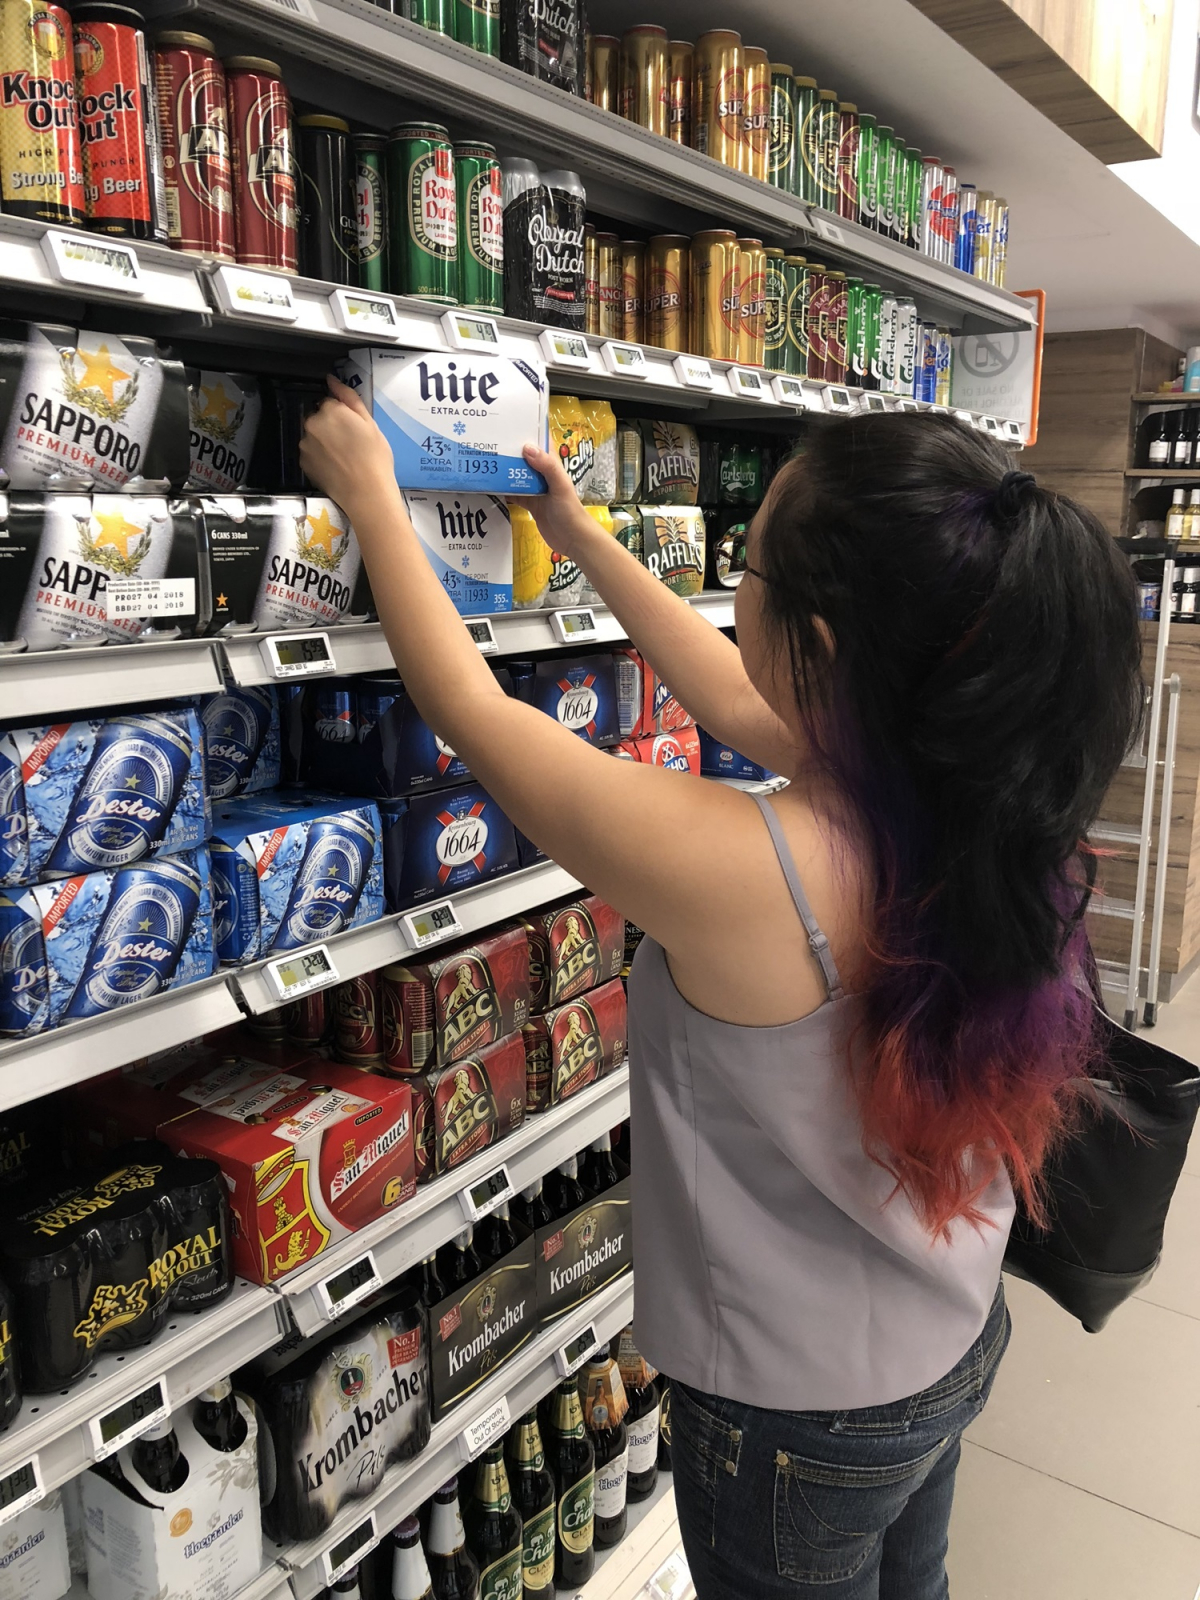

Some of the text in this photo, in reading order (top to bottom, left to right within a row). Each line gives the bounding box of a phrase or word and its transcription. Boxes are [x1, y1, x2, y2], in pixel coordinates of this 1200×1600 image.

[3, 73, 75, 104] Knoc
[28, 101, 75, 128] Out
[19, 148, 53, 158] HIGH
[93, 157, 134, 169] PUNCH
[11, 170, 65, 189] Strong
[103, 177, 141, 194] Beer
[426, 179, 455, 203] Roya
[413, 158, 437, 251] ROYAL PREMIUM
[471, 214, 493, 263] PREMIUM
[528, 205, 585, 253] Royal
[536, 244, 585, 274] Dutch
[900, 314, 916, 385] Carlsberg
[416, 361, 500, 405] hite
[514, 359, 539, 383] IMPORTED
[431, 407, 488, 417] EXTRA COLD
[20, 392, 141, 473] SAPPORO
[473, 442, 499, 450] POINT
[17, 426, 96, 468] PREMIUM
[99, 461, 128, 485] BEER
[420, 457, 452, 465] EXTRA
[465, 459, 499, 474] 1933
[508, 468, 528, 479] 355
[647, 454, 698, 493] RAFFLES
[211, 529, 248, 540] 6 CANS 330ml
[436, 501, 488, 539] hite
[648, 542, 704, 579] RAFFLES
[268, 555, 350, 612] SAPPORO
[468, 589, 489, 602] 1933
[494, 594, 506, 604] 355
[265, 583, 340, 620] PREMIUM BEER
[562, 696, 593, 723] 1664
[26, 730, 61, 771] IMPORTED
[208, 743, 249, 764] ester
[76, 795, 161, 823] Dester
[106, 853, 130, 863] LAGER
[261, 832, 283, 868] IMPORTED
[443, 827, 482, 859] 1664
[46, 882, 79, 924] IMPORTED
[294, 884, 352, 909] Dester
[313, 930, 330, 939] LAGER
[93, 939, 171, 970] Dester
[554, 942, 596, 996] ABC
[611, 948, 621, 959] 6x
[563, 969, 592, 996] EXTRA STOUT
[120, 993, 142, 1005] LAGER
[514, 998, 525, 1011] 6x
[443, 992, 493, 1054] ABC
[453, 1022, 488, 1055] EXTRA STOUT
[613, 1040, 623, 1051] 6x
[556, 1036, 598, 1091] ABC
[565, 1062, 593, 1092] EXTRA STOUT
[288, 1094, 346, 1138] San Miguel
[355, 1107, 382, 1125] IMPORTED
[511, 1097, 522, 1110] 6x
[441, 1095, 490, 1161] ABC
[452, 1126, 485, 1158] EXTRA STOUT
[333, 1161, 361, 1194] San
[362, 1112, 407, 1170] Miguel
[384, 1176, 402, 1207] 6
[33, 1195, 115, 1236] ROYAL
[34, 1197, 88, 1226] STOUT
[147, 1225, 222, 1290] ROYAL
[160, 1249, 213, 1294] STOUT
[550, 1233, 624, 1295] Krombacher
[448, 1299, 526, 1377] Krombacher
[297, 1368, 429, 1493] Krombacher
[470, 1406, 503, 1436] Temporarily
[474, 1416, 506, 1445] Out Of Stock
[346, 1444, 385, 1490] Pils
[184, 1508, 244, 1559] Hoegaarden
